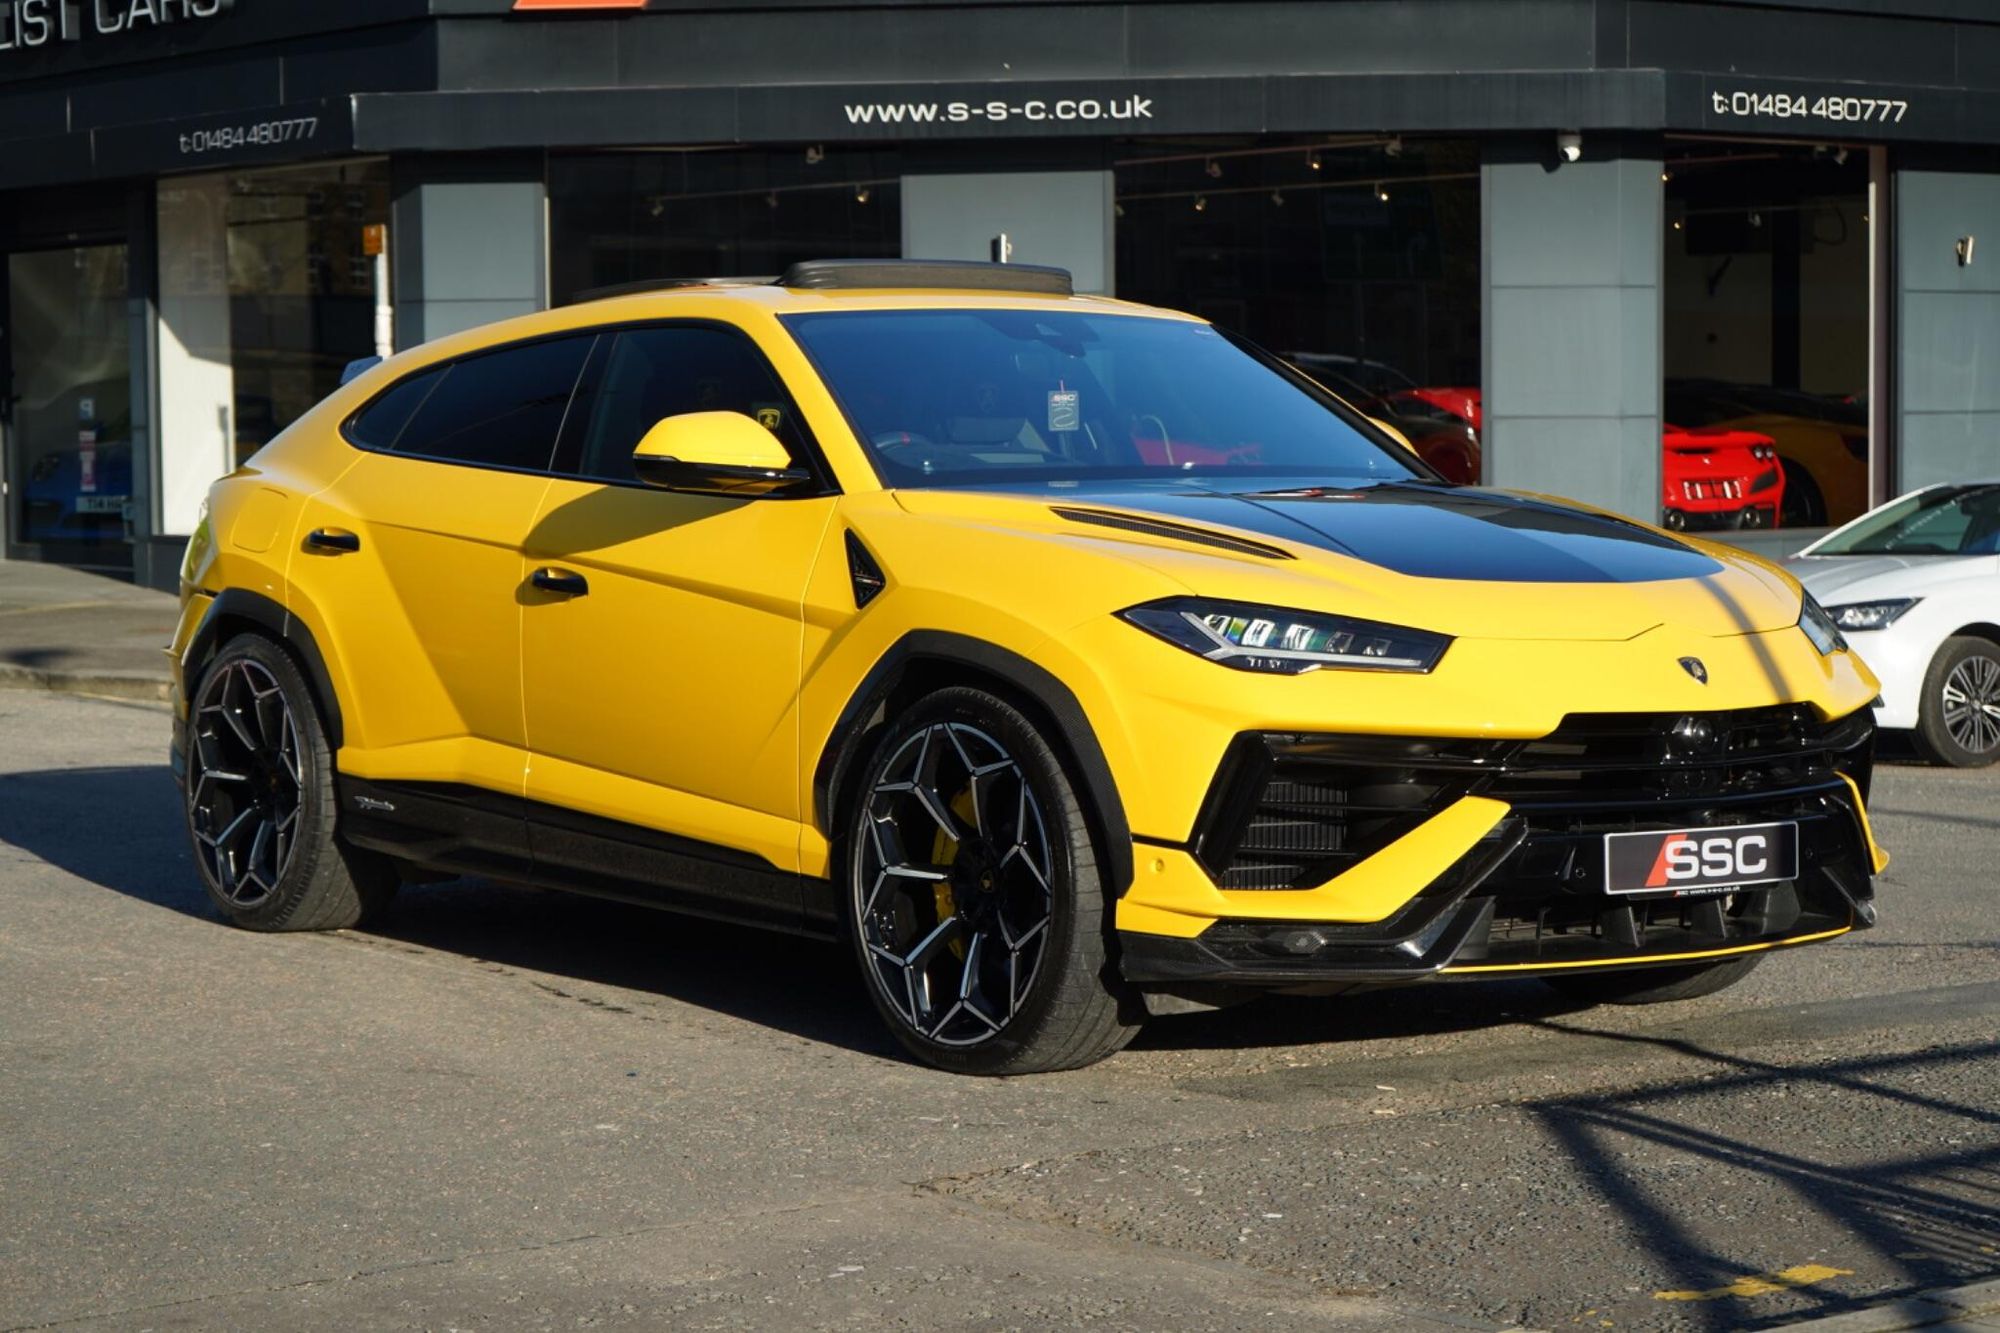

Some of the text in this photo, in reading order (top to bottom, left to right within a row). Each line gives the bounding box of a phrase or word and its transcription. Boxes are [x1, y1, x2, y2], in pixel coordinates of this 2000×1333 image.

[844, 94, 1153, 123] www.s-s-c.co.uk
[1811, 97, 1908, 123] 480777
[246, 117, 317, 145] 480777
[1665, 835, 1768, 880] SSC
